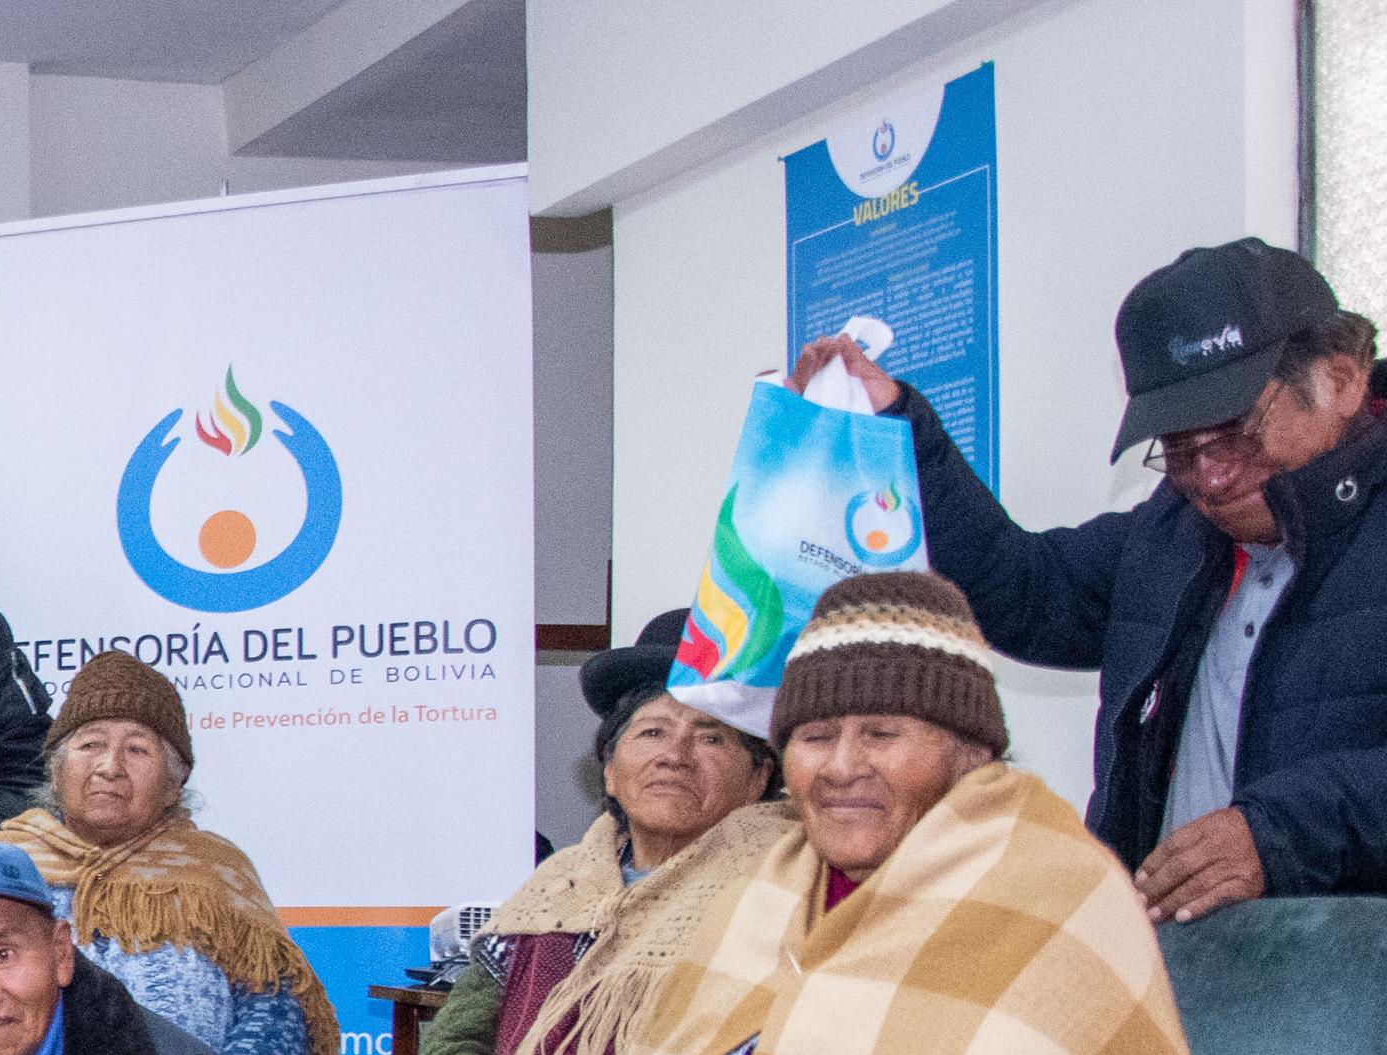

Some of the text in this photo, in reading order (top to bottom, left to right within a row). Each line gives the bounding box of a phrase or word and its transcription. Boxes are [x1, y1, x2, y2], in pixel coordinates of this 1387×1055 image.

[854, 181, 920, 225] VALORES
[243, 627, 317, 662] DEL
[331, 618, 497, 660] PUEBLO
[174, 663, 497, 691] NACIONAL DE BOLIVIA
[200, 712, 225, 729] de
[232, 708, 351, 729] Prevención
[359, 707, 385, 724] de
[392, 705, 409, 722] la
[415, 704, 498, 722] Tortura
